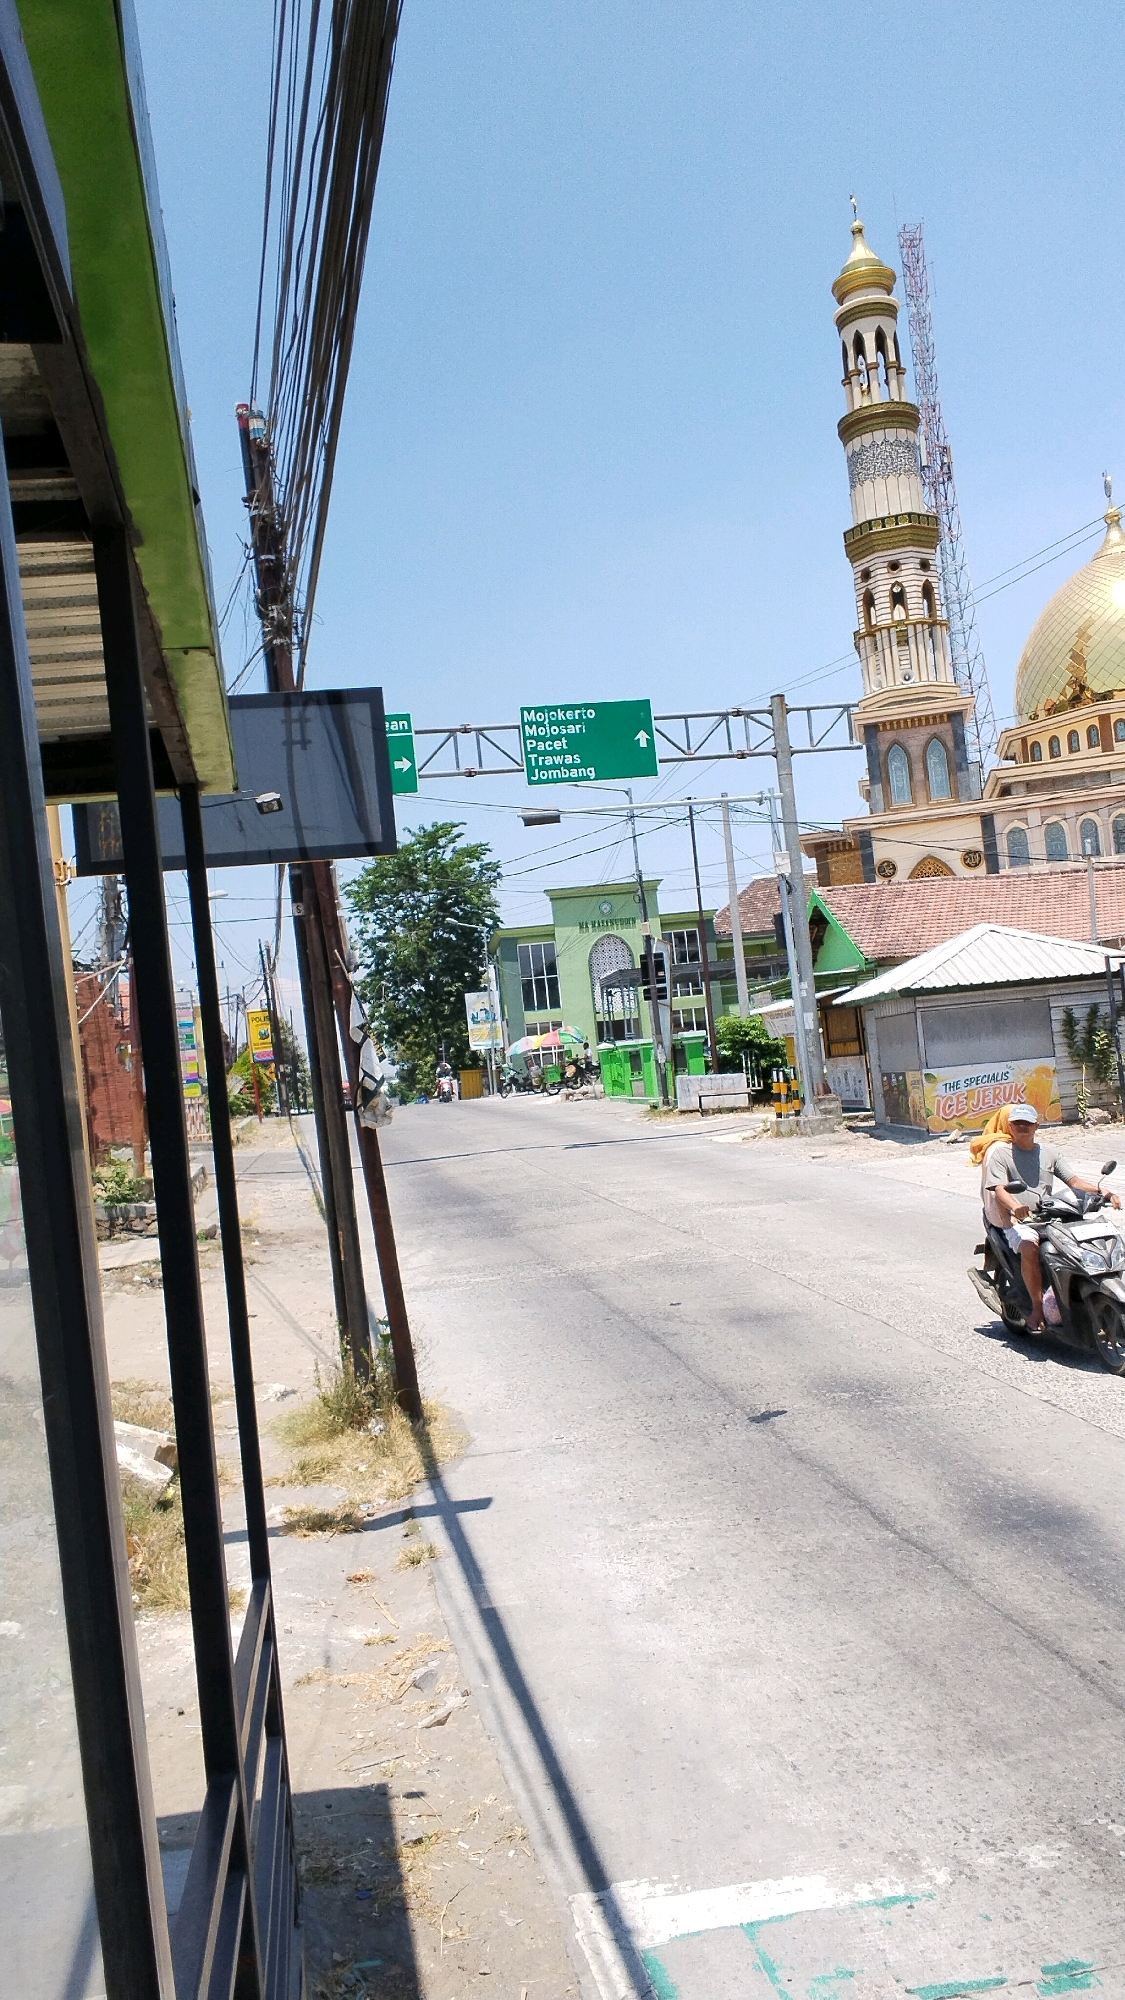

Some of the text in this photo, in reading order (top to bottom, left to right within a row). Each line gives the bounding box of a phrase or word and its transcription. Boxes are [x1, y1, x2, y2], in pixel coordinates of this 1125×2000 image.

[523, 707, 596, 724] Mojokerto
[524, 722, 586, 738] Mojosari
[526, 737, 568, 751] Pacet
[528, 754, 581, 766] Trawas
[531, 766, 596, 780] Jombang
[942, 1080, 961, 1093] THE
[935, 1082, 1027, 1120] ICE JERUK
